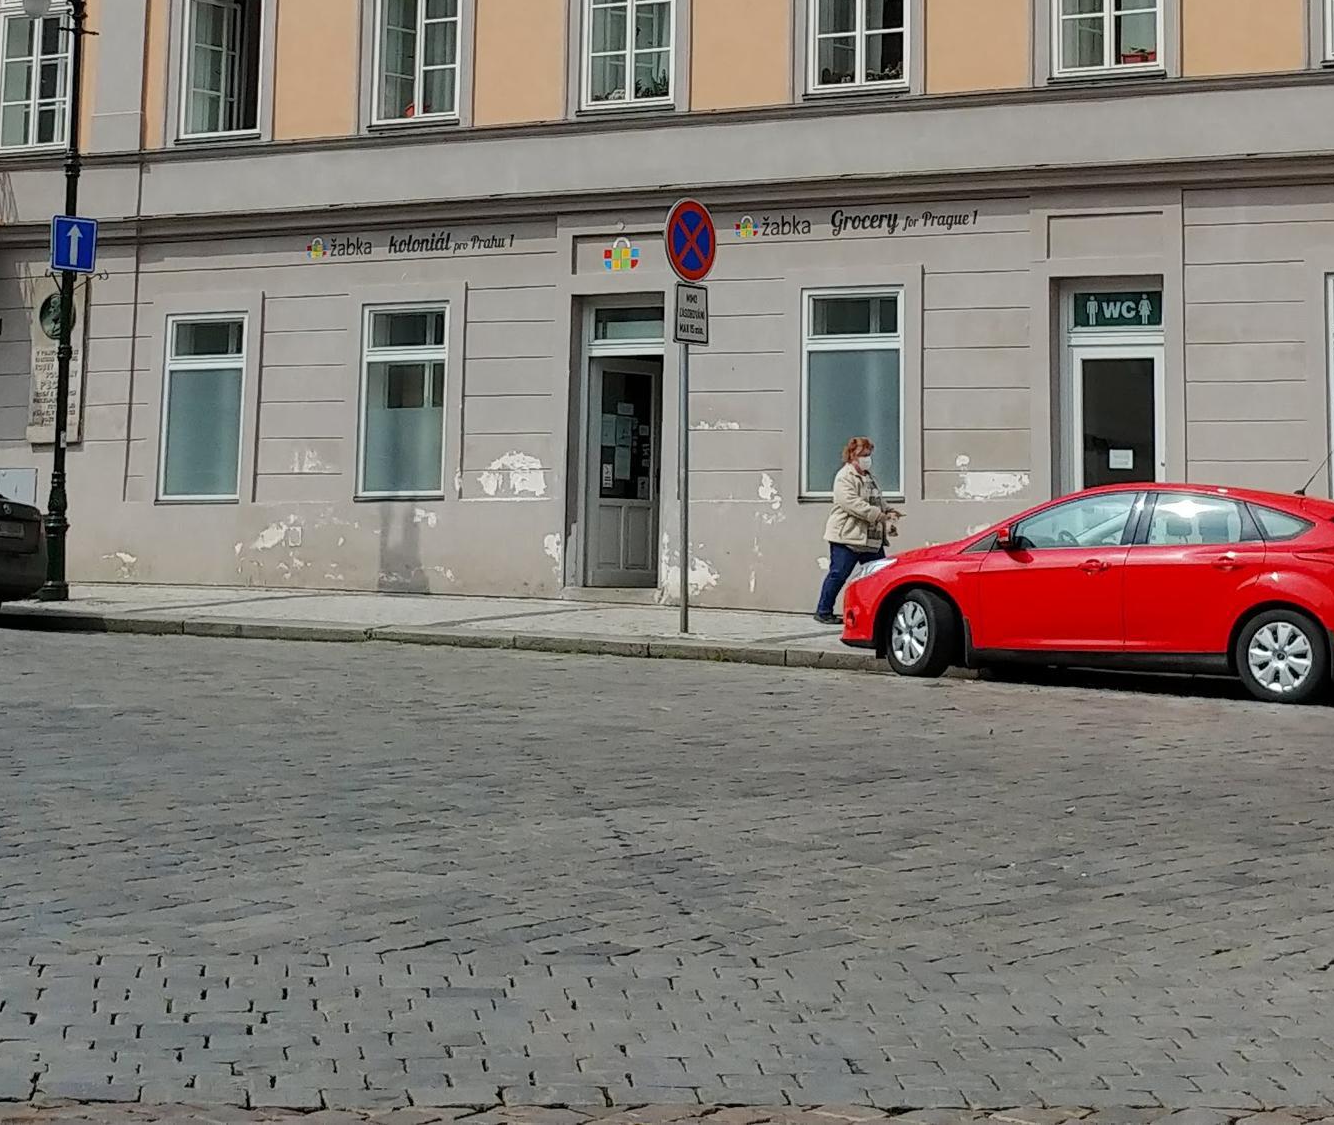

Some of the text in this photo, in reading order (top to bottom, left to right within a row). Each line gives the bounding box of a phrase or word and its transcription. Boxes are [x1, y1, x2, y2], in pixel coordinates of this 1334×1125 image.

[762, 217, 811, 236] žabka
[831, 210, 978, 236] Grocery for Prague 1
[330, 238, 372, 257] žabka
[388, 231, 515, 254] koloniál pro Prahu 1
[1102, 300, 1137, 319] WC
